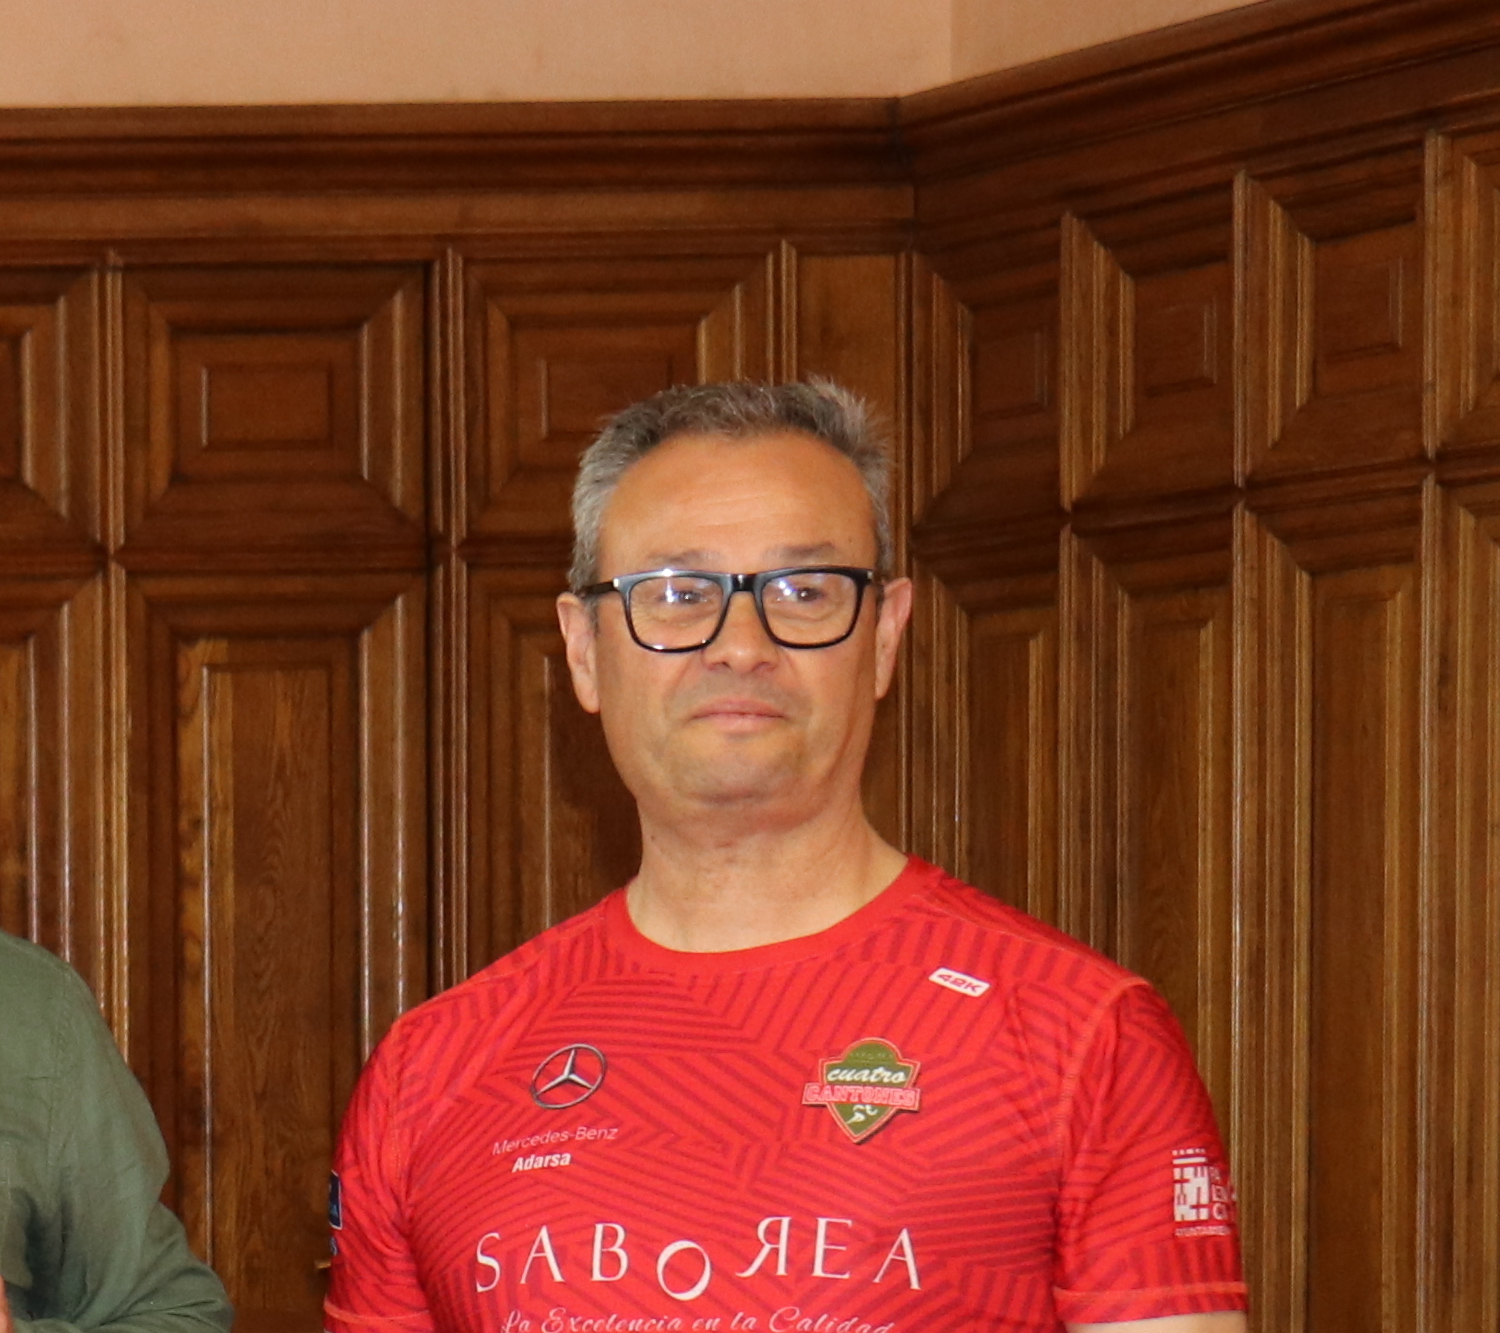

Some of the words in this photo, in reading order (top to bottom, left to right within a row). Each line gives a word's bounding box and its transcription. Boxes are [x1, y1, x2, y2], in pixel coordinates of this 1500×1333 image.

[826, 1066, 908, 1084] cuatro
[804, 1084, 917, 1108] CANTONES
[491, 1126, 619, 1156] Mercedes-Benz
[511, 1152, 573, 1173] Adarsa
[692, 1316, 718, 1332] en
[731, 1311, 758, 1331] la
